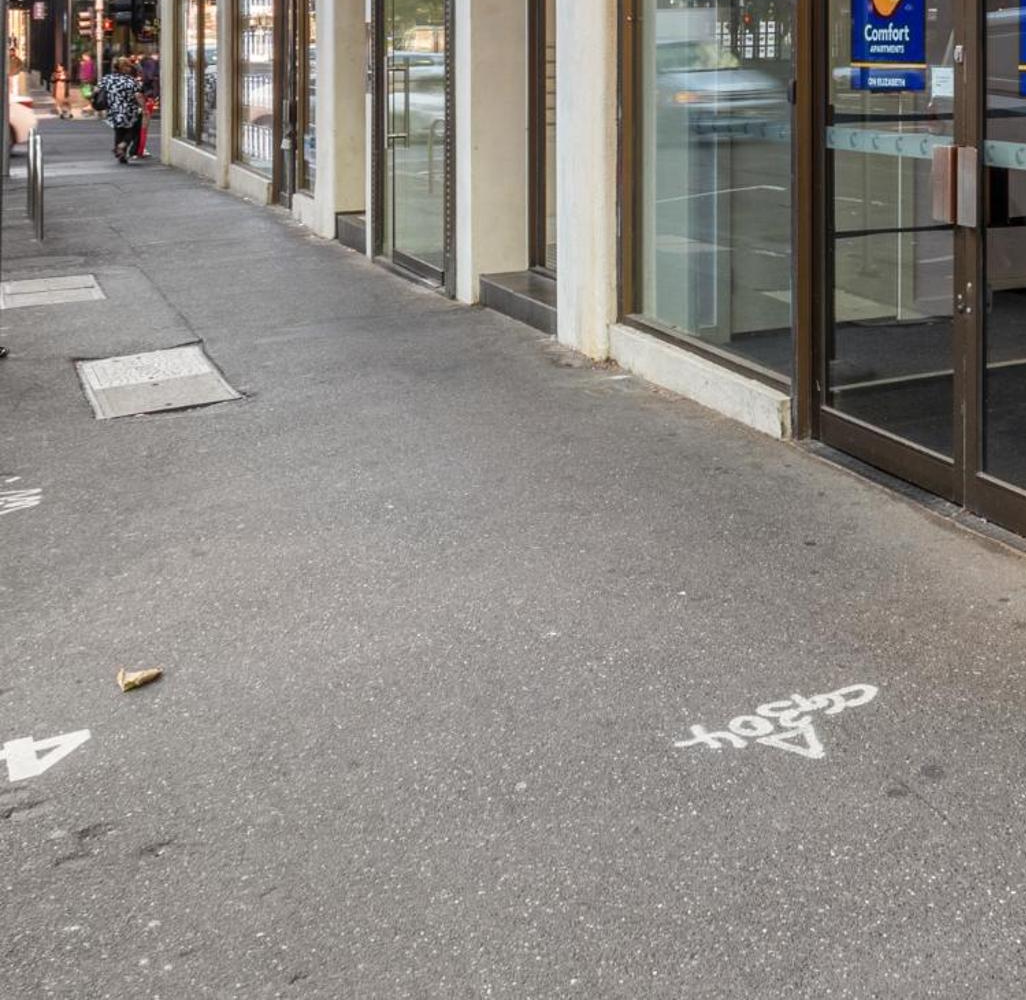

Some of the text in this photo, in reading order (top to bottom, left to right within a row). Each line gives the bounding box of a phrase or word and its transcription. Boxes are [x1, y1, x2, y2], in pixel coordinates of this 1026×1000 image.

[864, 22, 910, 41] Comfort
[869, 44, 905, 54] APARTMENTS
[868, 77, 906, 87] ON ELIZABETH
